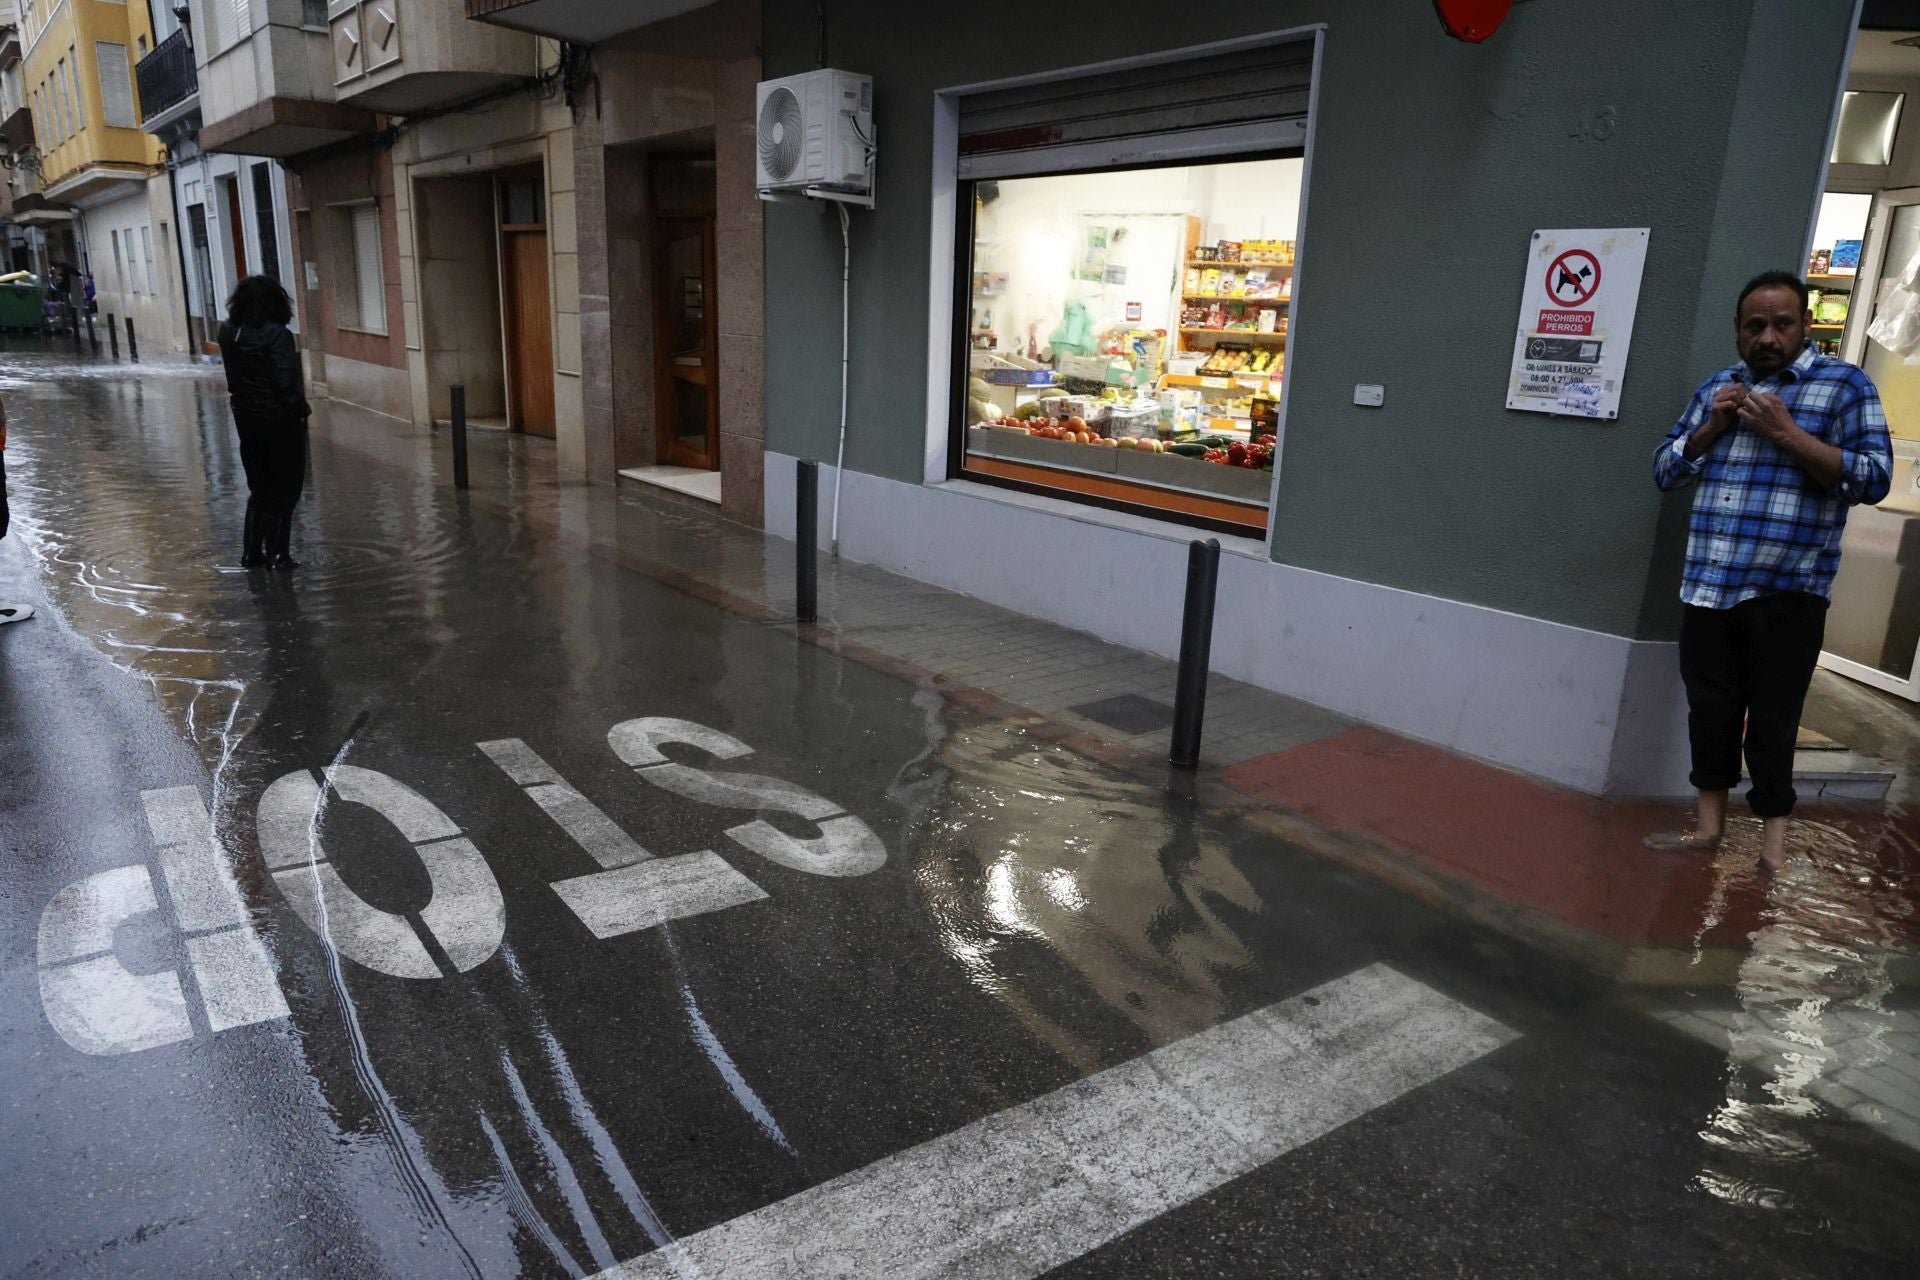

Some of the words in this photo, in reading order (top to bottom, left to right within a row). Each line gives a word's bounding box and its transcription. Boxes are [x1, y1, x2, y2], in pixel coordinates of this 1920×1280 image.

[1541, 313, 1592, 323] PROHIBIDO
[1546, 322, 1584, 332] PERROS
[1526, 363, 1535, 371] DE
[1537, 364, 1556, 373] LUNES
[37, 717, 888, 1057] STOP
